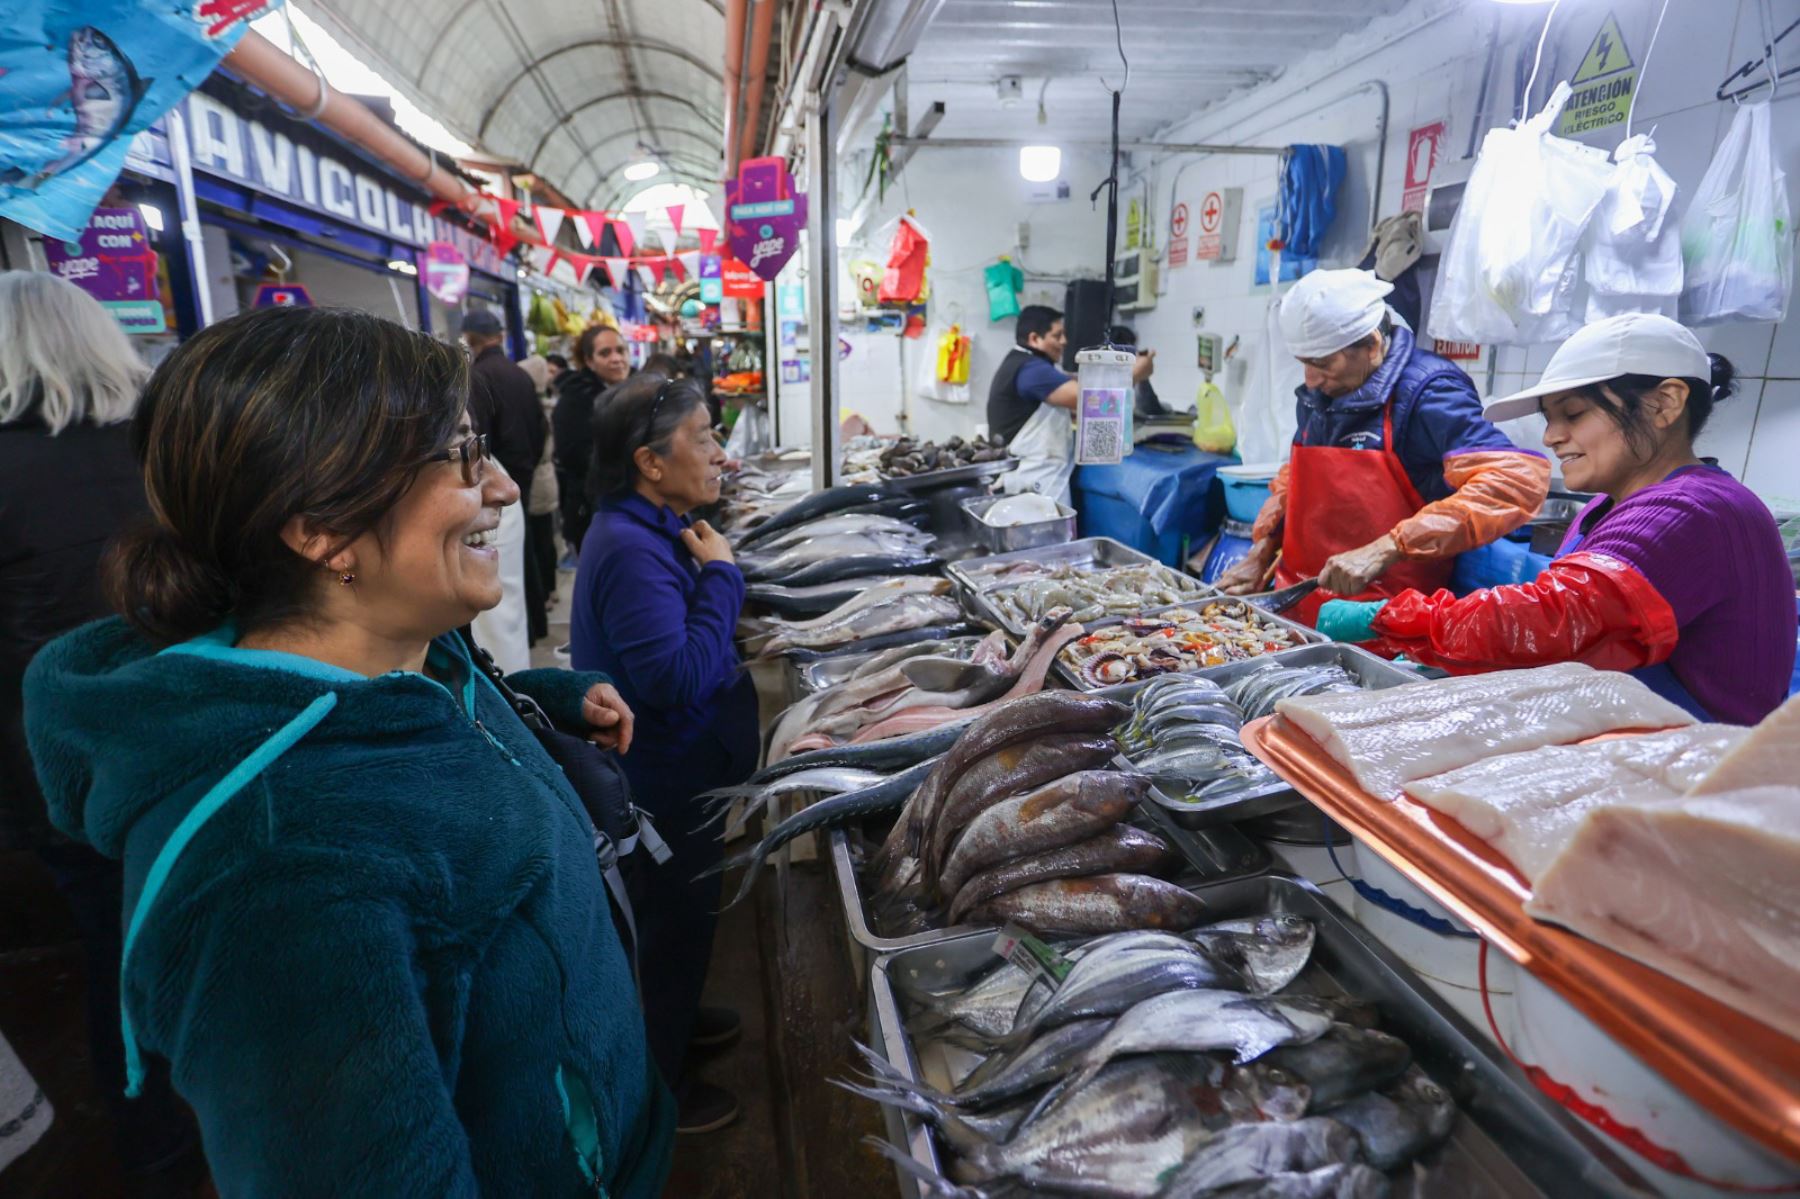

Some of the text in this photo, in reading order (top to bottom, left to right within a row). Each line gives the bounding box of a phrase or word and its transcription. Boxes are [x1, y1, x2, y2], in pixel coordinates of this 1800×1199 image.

[1565, 76, 1633, 112] ATENCIÓN
[187, 90, 435, 245] AVICOLA
[93, 214, 135, 230] AQUÍ
[97, 234, 132, 248] CON
[749, 237, 785, 269] yape
[58, 257, 99, 280] yape
